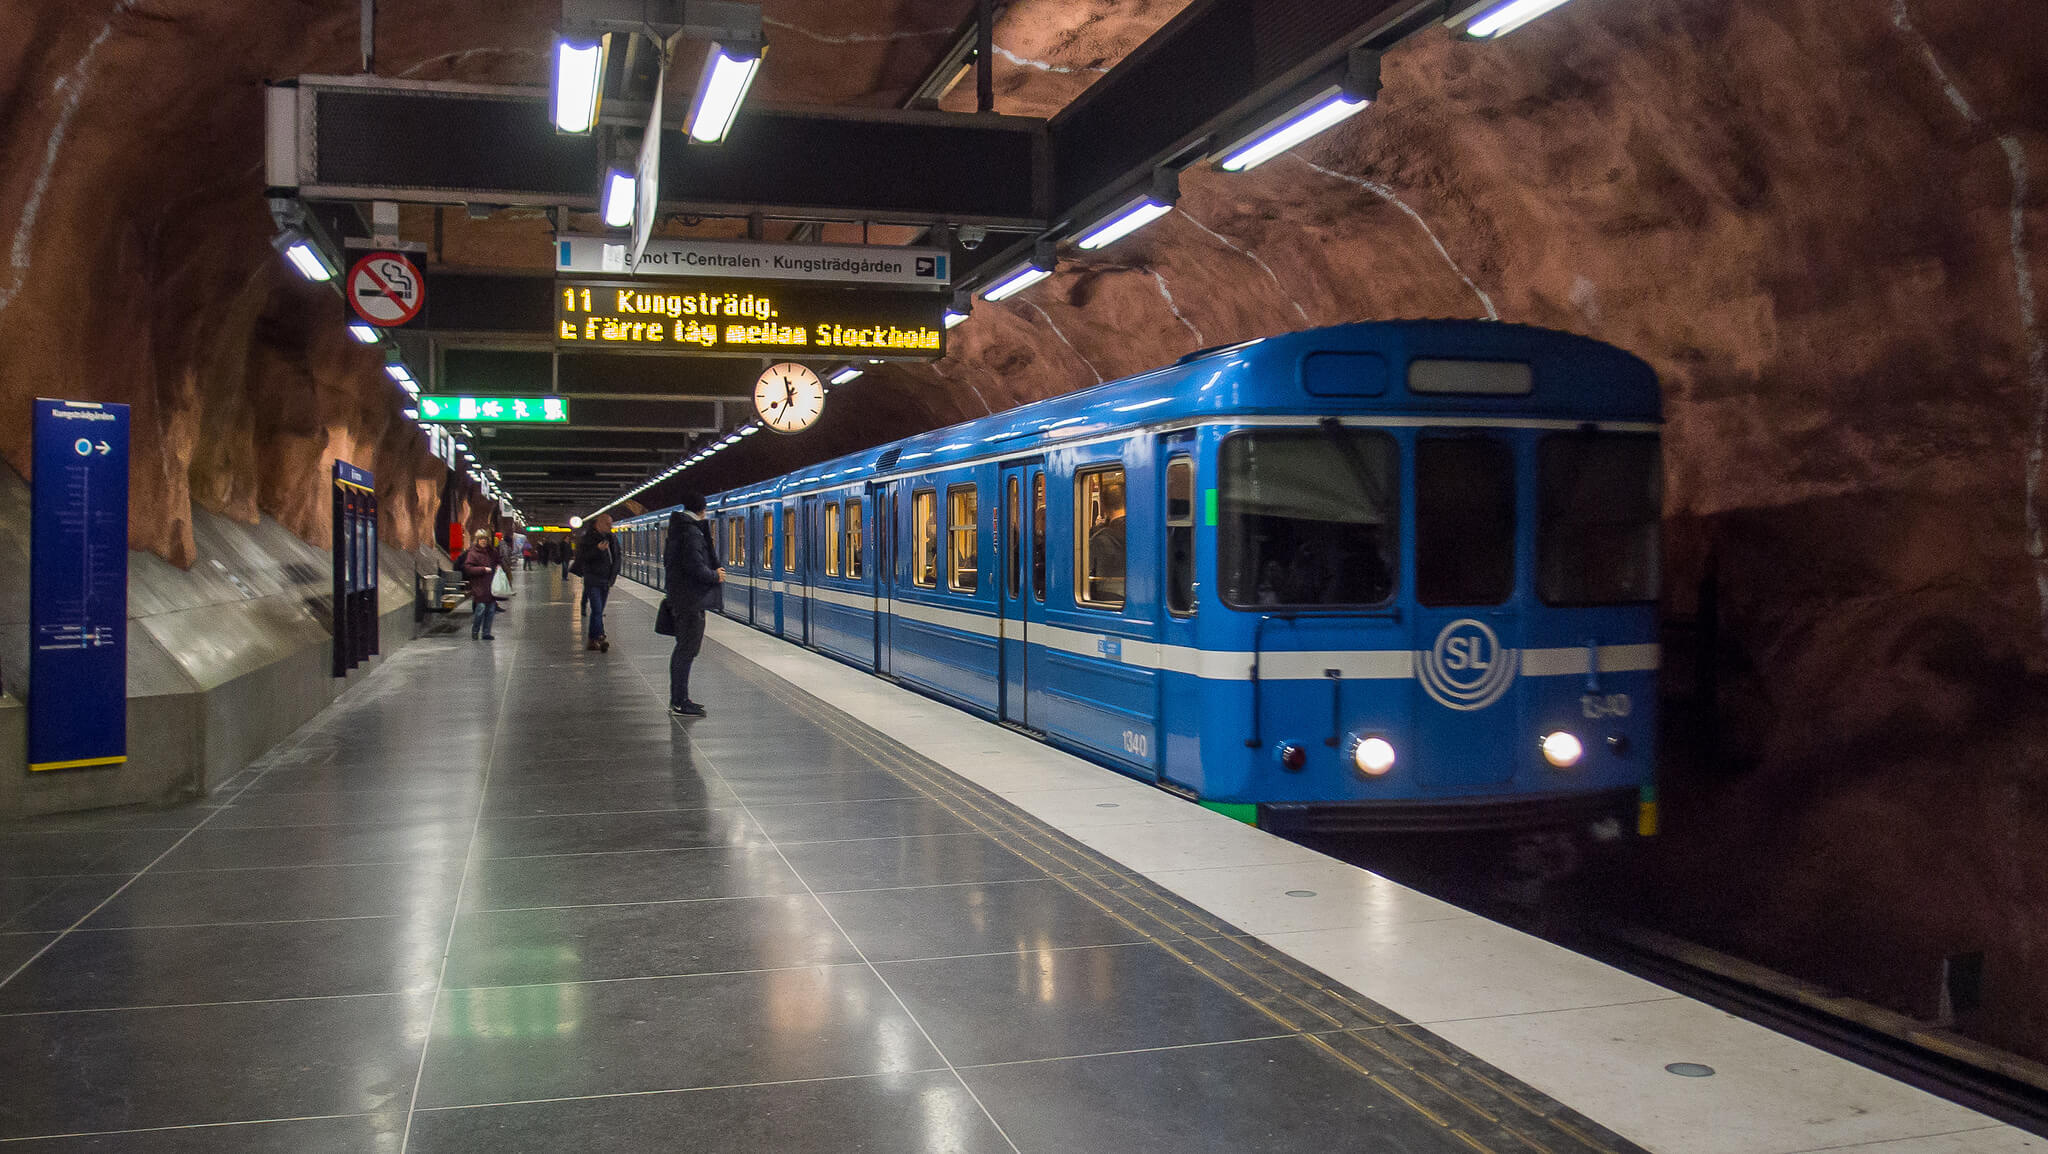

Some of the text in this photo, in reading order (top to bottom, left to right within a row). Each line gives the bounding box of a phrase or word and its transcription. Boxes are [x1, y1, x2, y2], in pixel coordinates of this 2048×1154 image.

[672, 251, 760, 268] T-Centralen
[773, 255, 902, 273] Kungsträdgården
[562, 288, 778, 320] 11 Kungsträdg.
[584, 317, 664, 342] Färre
[674, 319, 718, 347] tåg
[815, 323, 940, 349] Stockholm
[1445, 636, 1490, 670] SL
[1122, 730, 1149, 757] 1340
